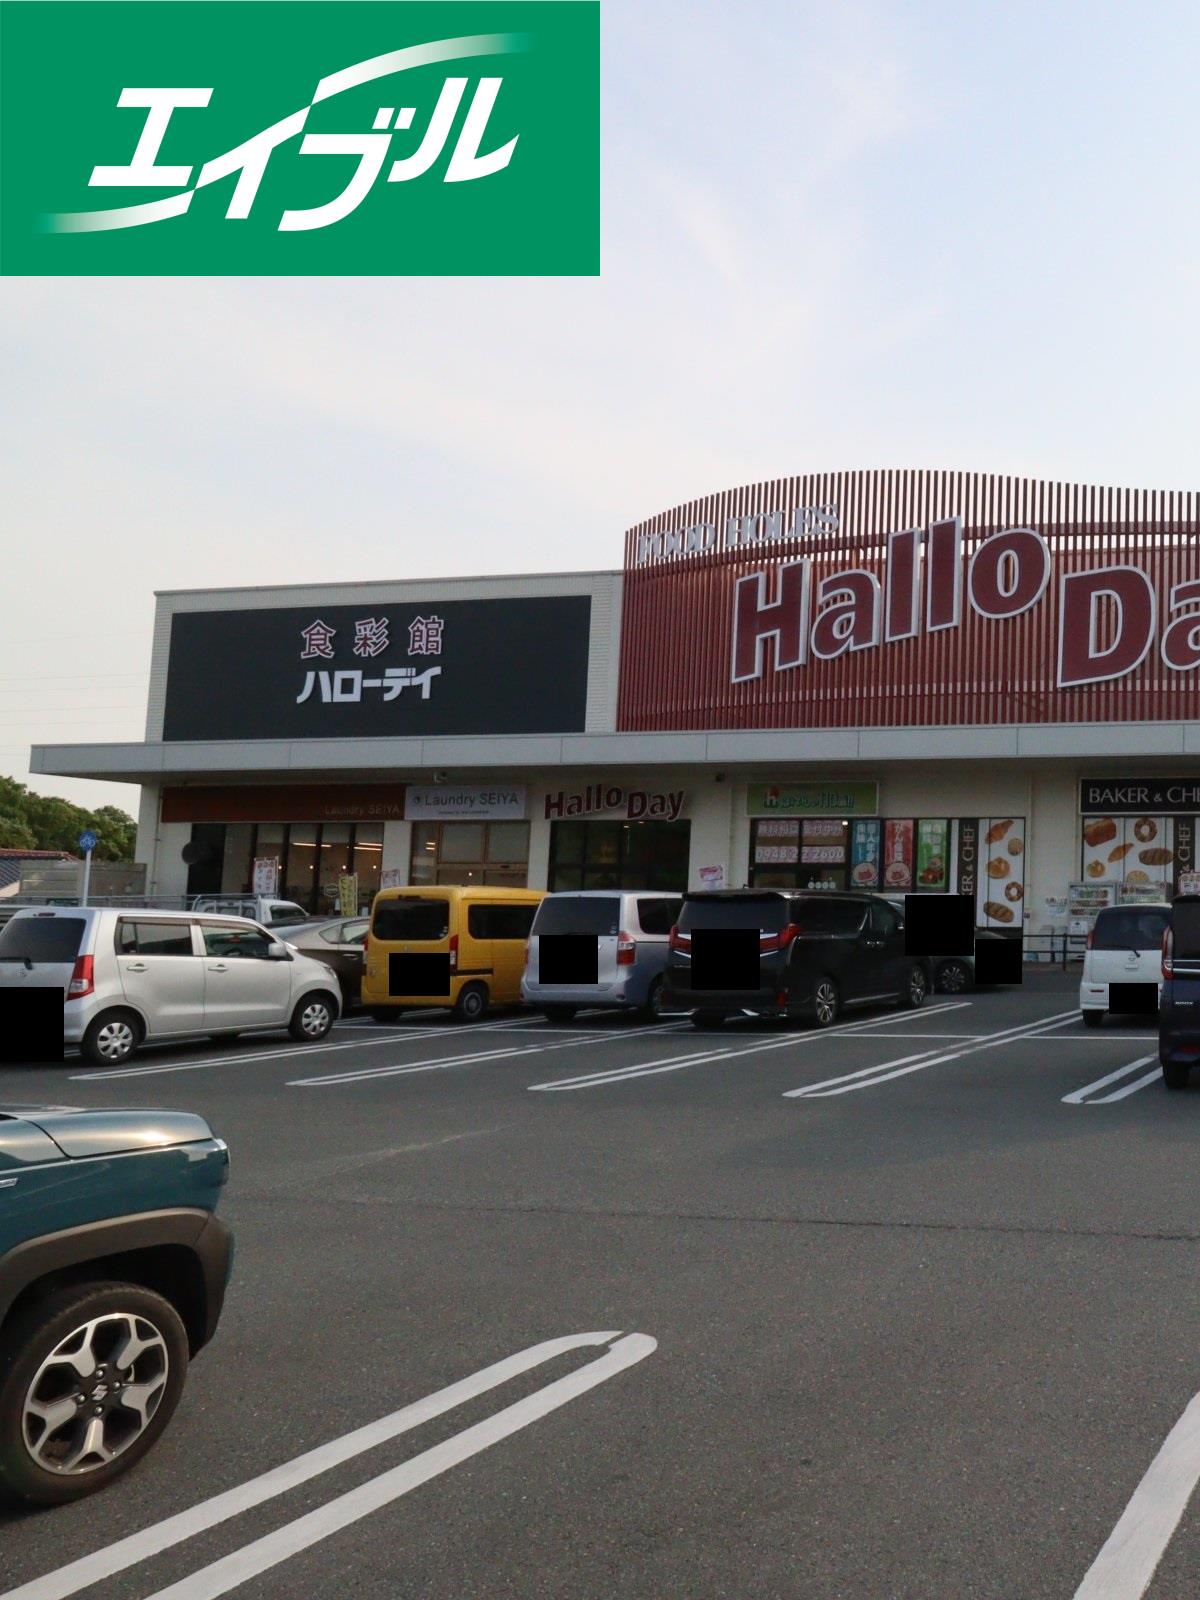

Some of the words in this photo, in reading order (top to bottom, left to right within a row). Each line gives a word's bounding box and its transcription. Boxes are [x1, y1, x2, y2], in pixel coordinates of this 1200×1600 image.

[637, 523, 716, 565] FOOD
[731, 516, 1051, 684] Hallo
[300, 614, 445, 659] 食彩館
[296, 665, 442, 704] ハローデイ
[425, 793, 475, 809] Laundry
[479, 791, 519, 805] SEIYA
[544, 783, 624, 820] Hallo
[626, 790, 686, 822] Day
[1088, 787, 1150, 804] BAKER
[962, 824, 975, 862] CHEF
[1178, 823, 1191, 862] CHEF
